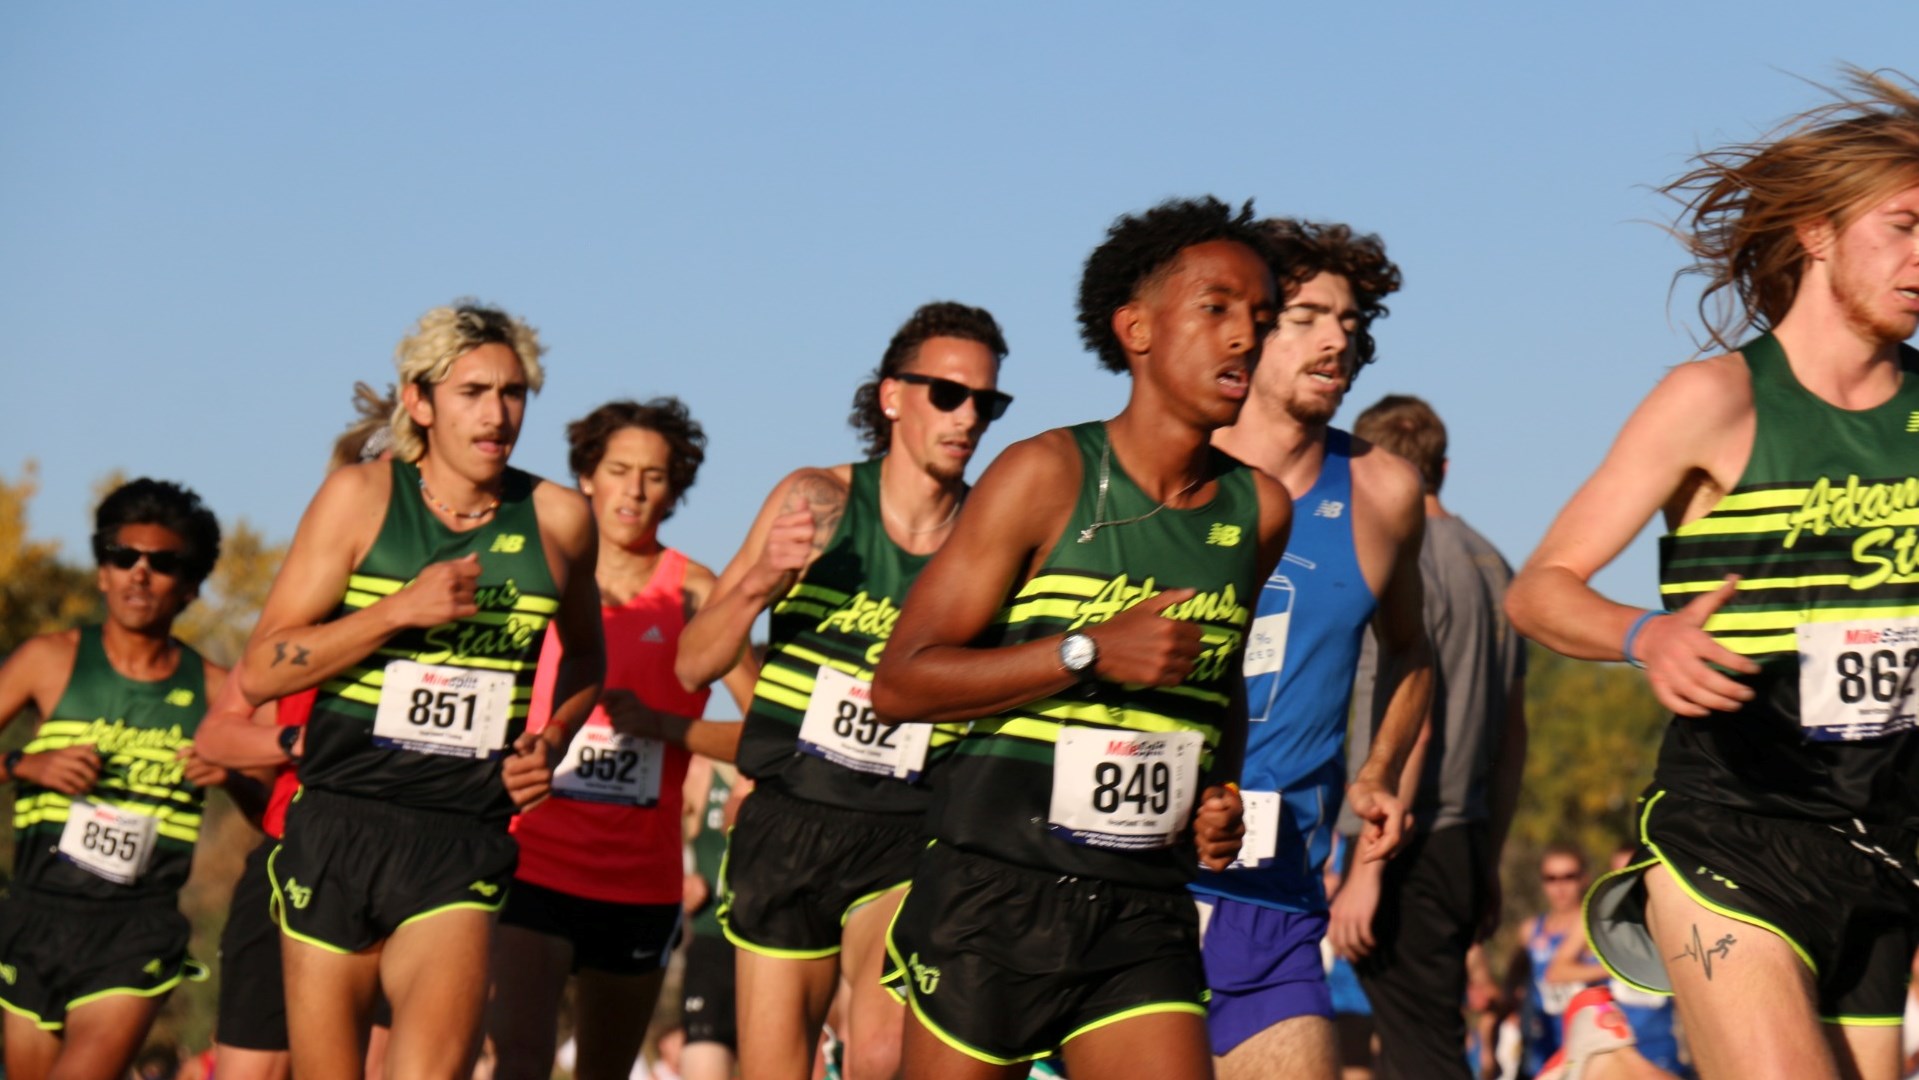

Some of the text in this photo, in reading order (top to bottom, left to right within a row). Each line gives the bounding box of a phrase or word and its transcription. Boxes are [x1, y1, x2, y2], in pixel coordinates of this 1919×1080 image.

[1783, 474, 1919, 549] Adam
[408, 688, 477, 732] 851
[833, 700, 897, 749] 852
[576, 747, 638, 784] 952
[1093, 761, 1169, 815] 849
[82, 822, 139, 862] 855
